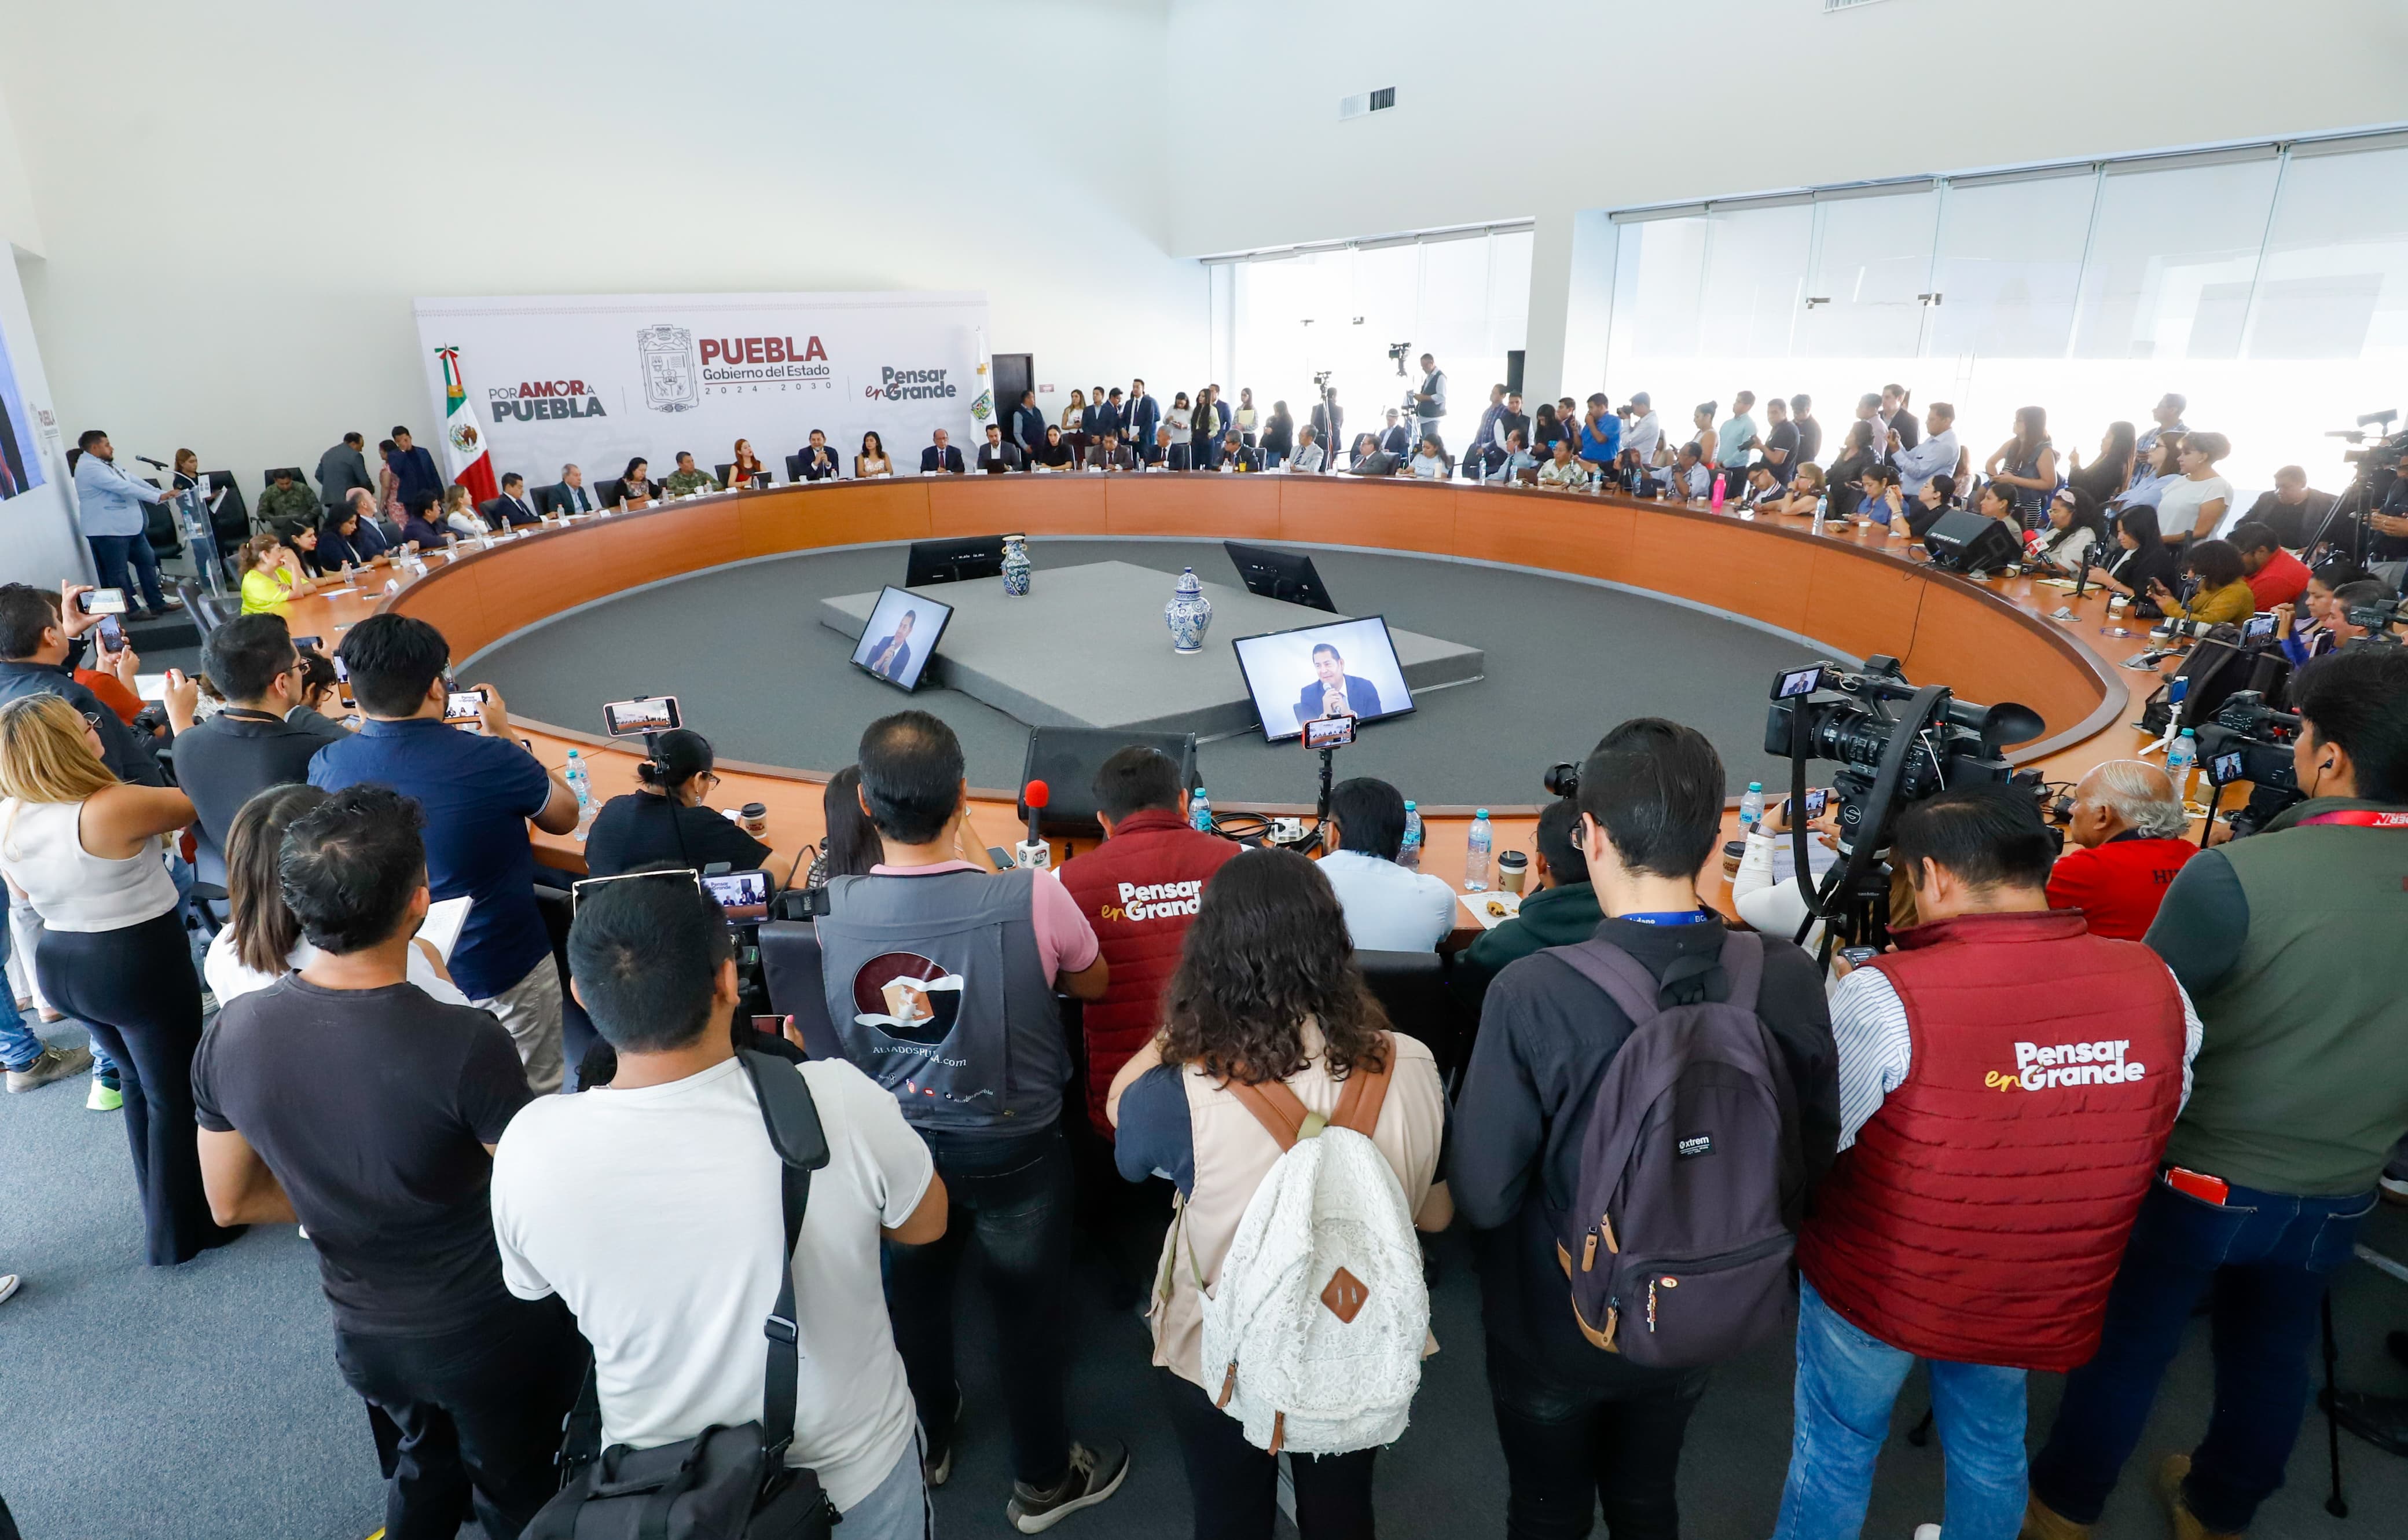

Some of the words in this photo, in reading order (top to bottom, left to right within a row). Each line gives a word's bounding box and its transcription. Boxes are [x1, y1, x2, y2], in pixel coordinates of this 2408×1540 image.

[699, 336, 828, 366] PUEBLA
[703, 366, 763, 380] Gobierno
[765, 365, 785, 378] del
[787, 364, 830, 377] Estado
[882, 366, 947, 384] Pensar
[489, 387, 518, 399] POR
[518, 380, 586, 398] AMOR
[586, 384, 596, 395] A
[706, 384, 758, 395] 2024
[781, 382, 831, 391] 2030
[865, 385, 887, 401] en
[886, 380, 957, 401] Grande
[490, 396, 607, 423] PUEBLA
[1118, 879, 1202, 903] Pensar
[1101, 904, 1128, 922] en
[1125, 892, 1202, 922] Grand
[2014, 1039, 2130, 1070] Pensar
[1985, 1070, 2024, 1092] en
[2020, 1057, 2146, 1092] Grande
[1685, 1136, 1709, 1148] xtrem
